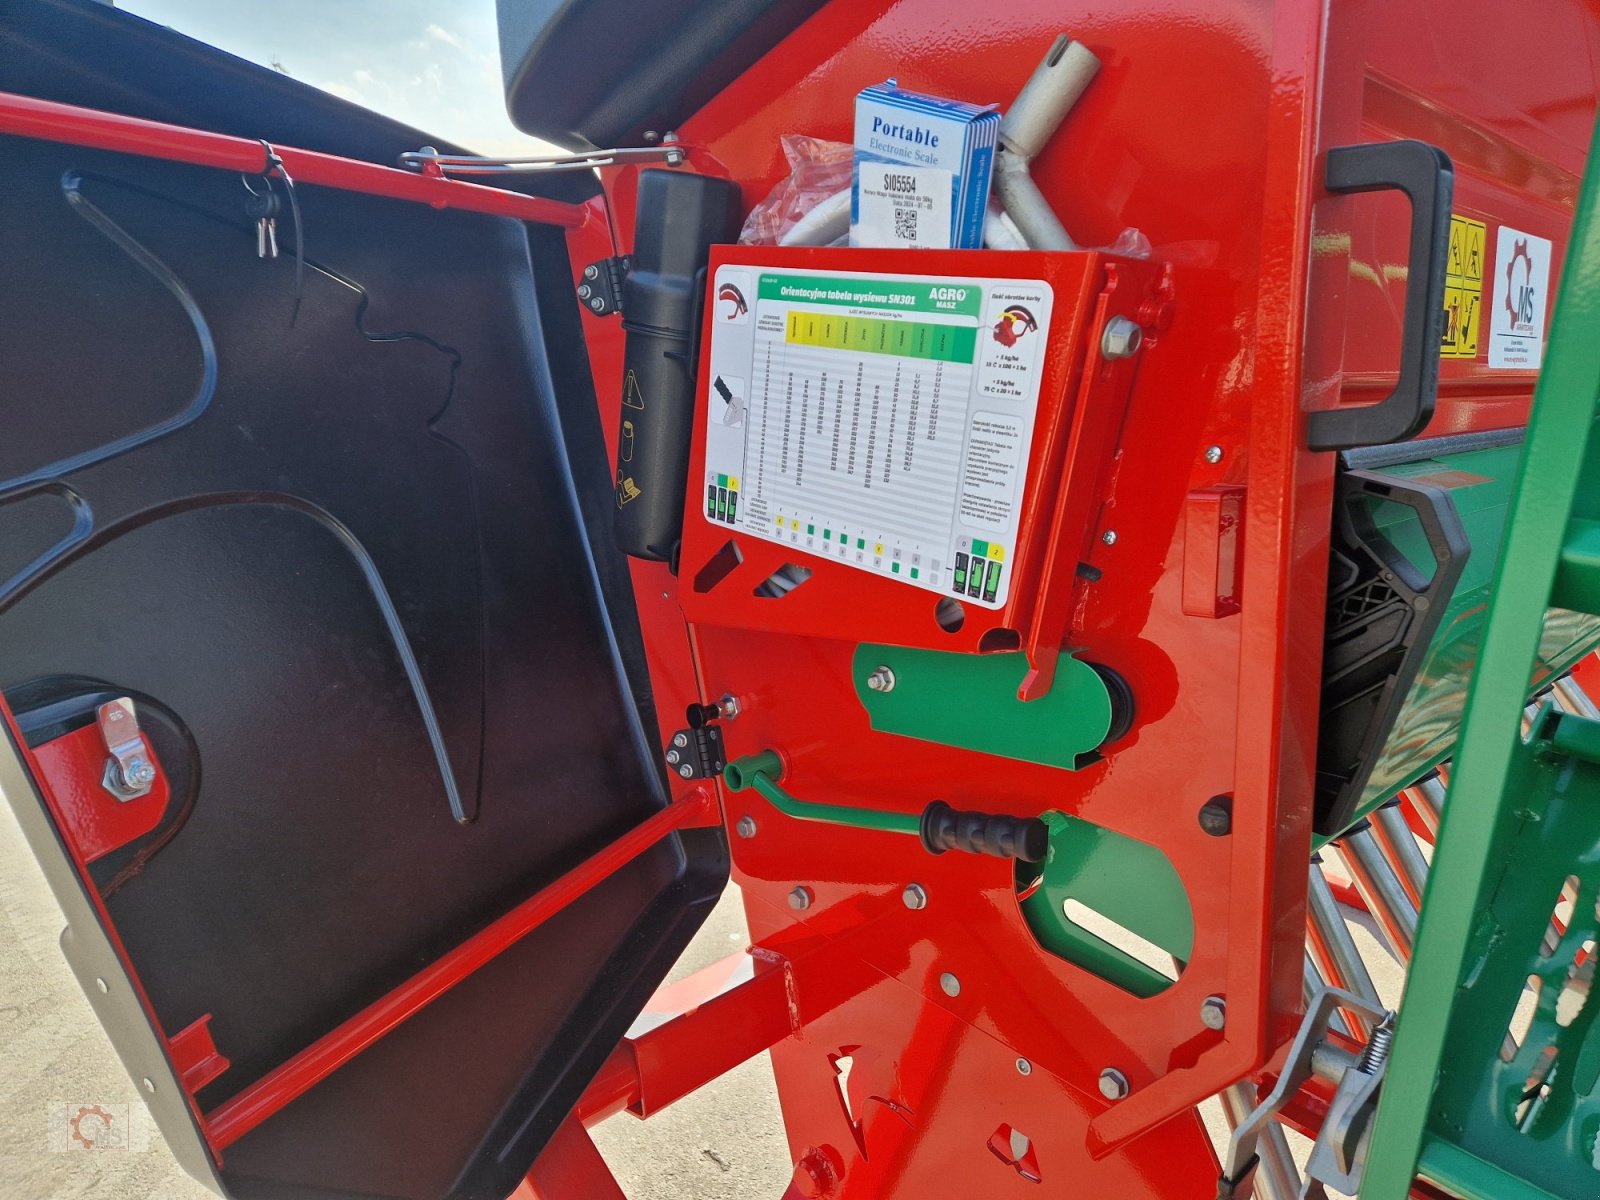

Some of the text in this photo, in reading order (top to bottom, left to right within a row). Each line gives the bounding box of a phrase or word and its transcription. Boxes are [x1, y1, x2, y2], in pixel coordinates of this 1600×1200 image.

[872, 116, 939, 148] Portable
[869, 138, 938, 165] Electronic Scale
[883, 173, 916, 193] SI05554
[780, 286, 916, 305] Orientacyjna tabela wysiewu SN301
[929, 287, 967, 302] AGRO
[1517, 285, 1534, 324] MS
[936, 301, 957, 310] MASZ
